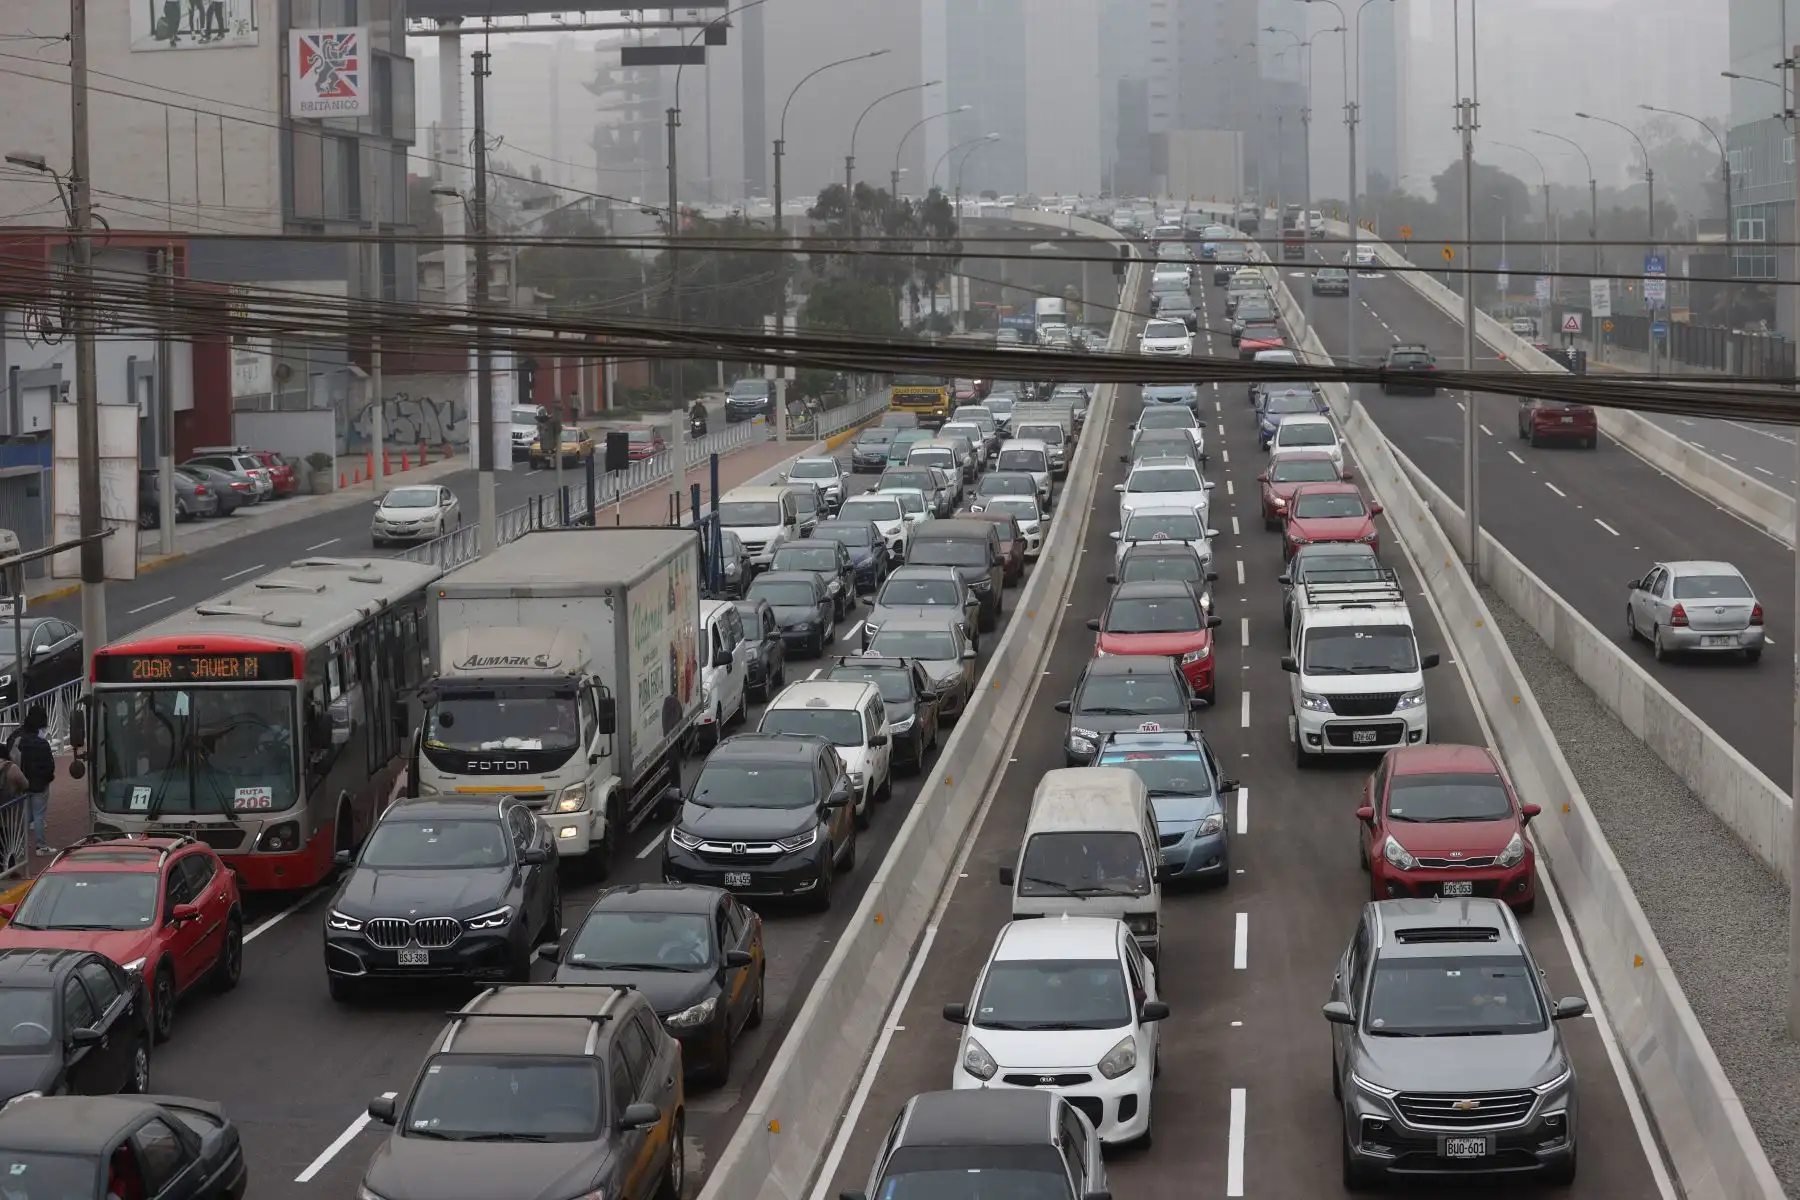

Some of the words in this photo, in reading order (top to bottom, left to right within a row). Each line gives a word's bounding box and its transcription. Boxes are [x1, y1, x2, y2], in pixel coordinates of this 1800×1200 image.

[462, 654, 531, 667] AUMARK
[190, 657, 240, 678] JAVIER
[467, 760, 530, 771] FOTON
[239, 788, 264, 796] RUTA
[133, 794, 148, 805] 11
[234, 795, 271, 809] 206
